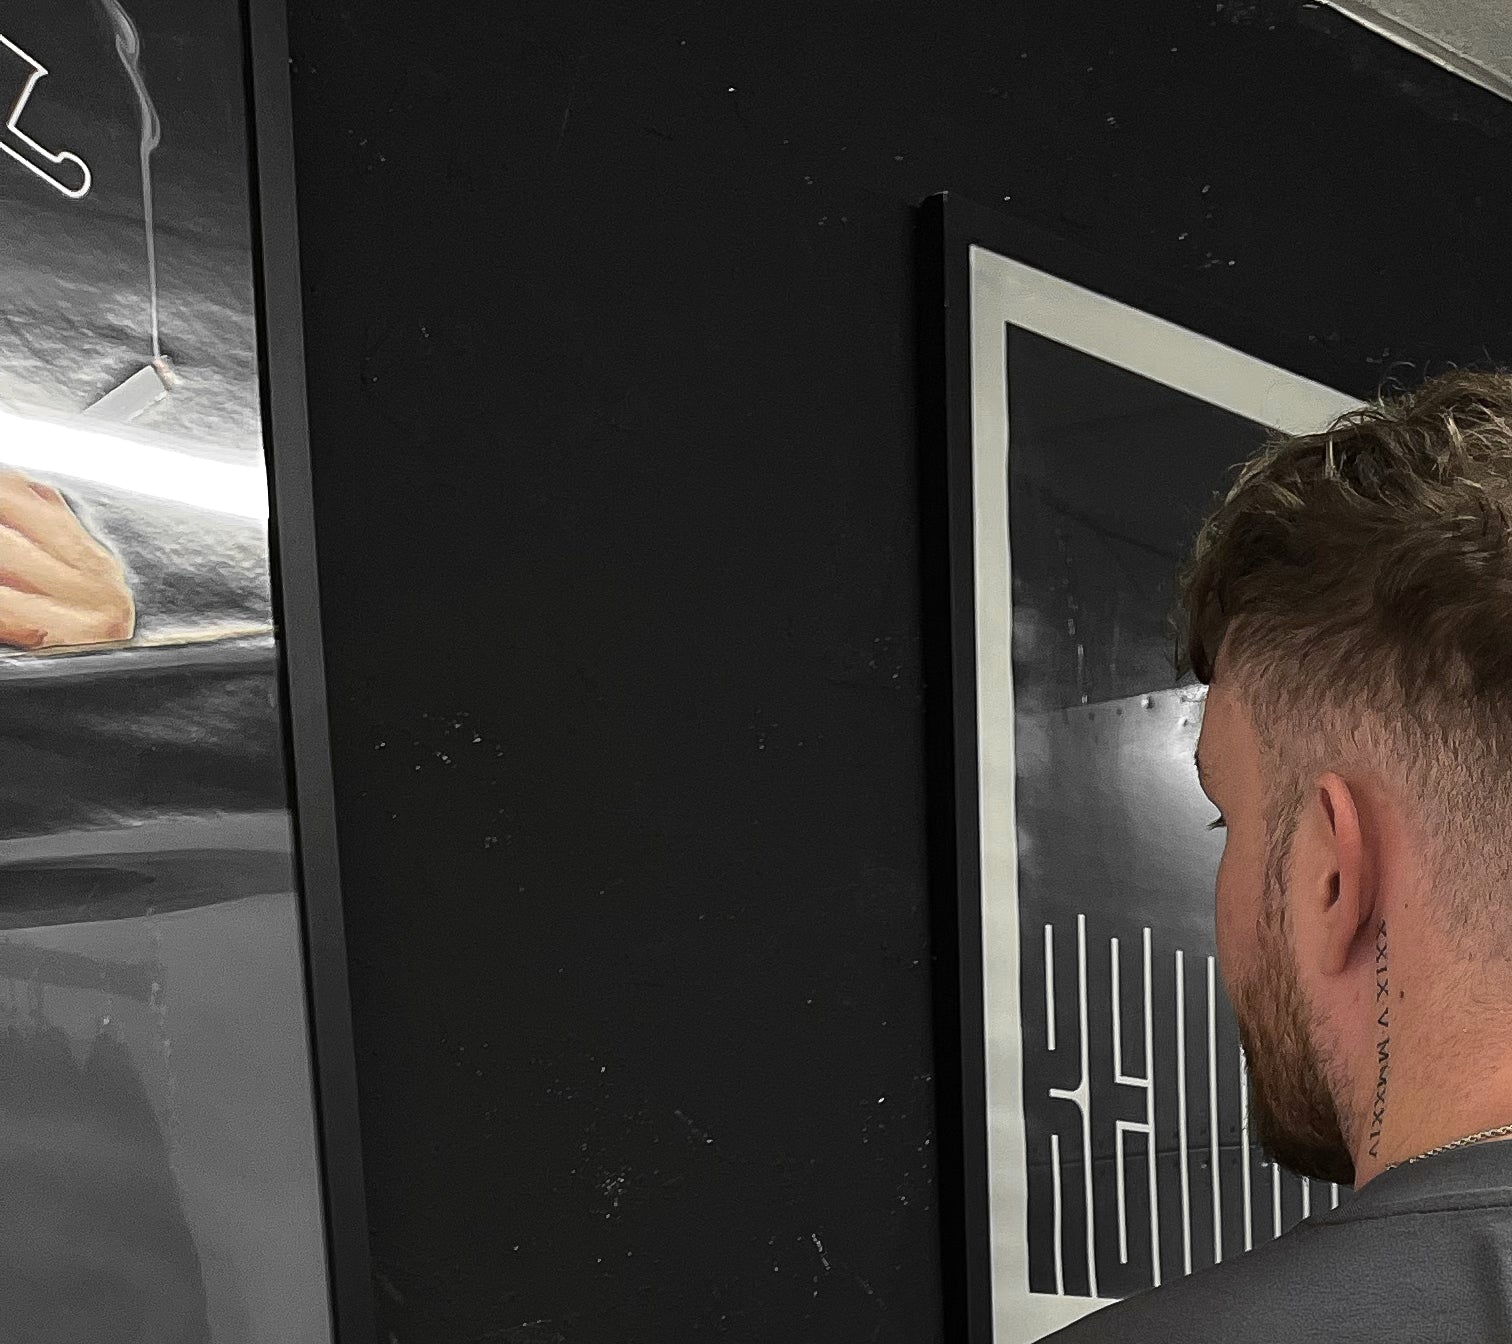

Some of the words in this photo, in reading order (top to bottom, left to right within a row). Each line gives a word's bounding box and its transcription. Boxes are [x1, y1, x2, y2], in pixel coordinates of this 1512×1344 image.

[1376, 918, 1389, 1002] XXIX
[1378, 1007, 1389, 1027] V
[1368, 1037, 1389, 1158] MMXXIV
